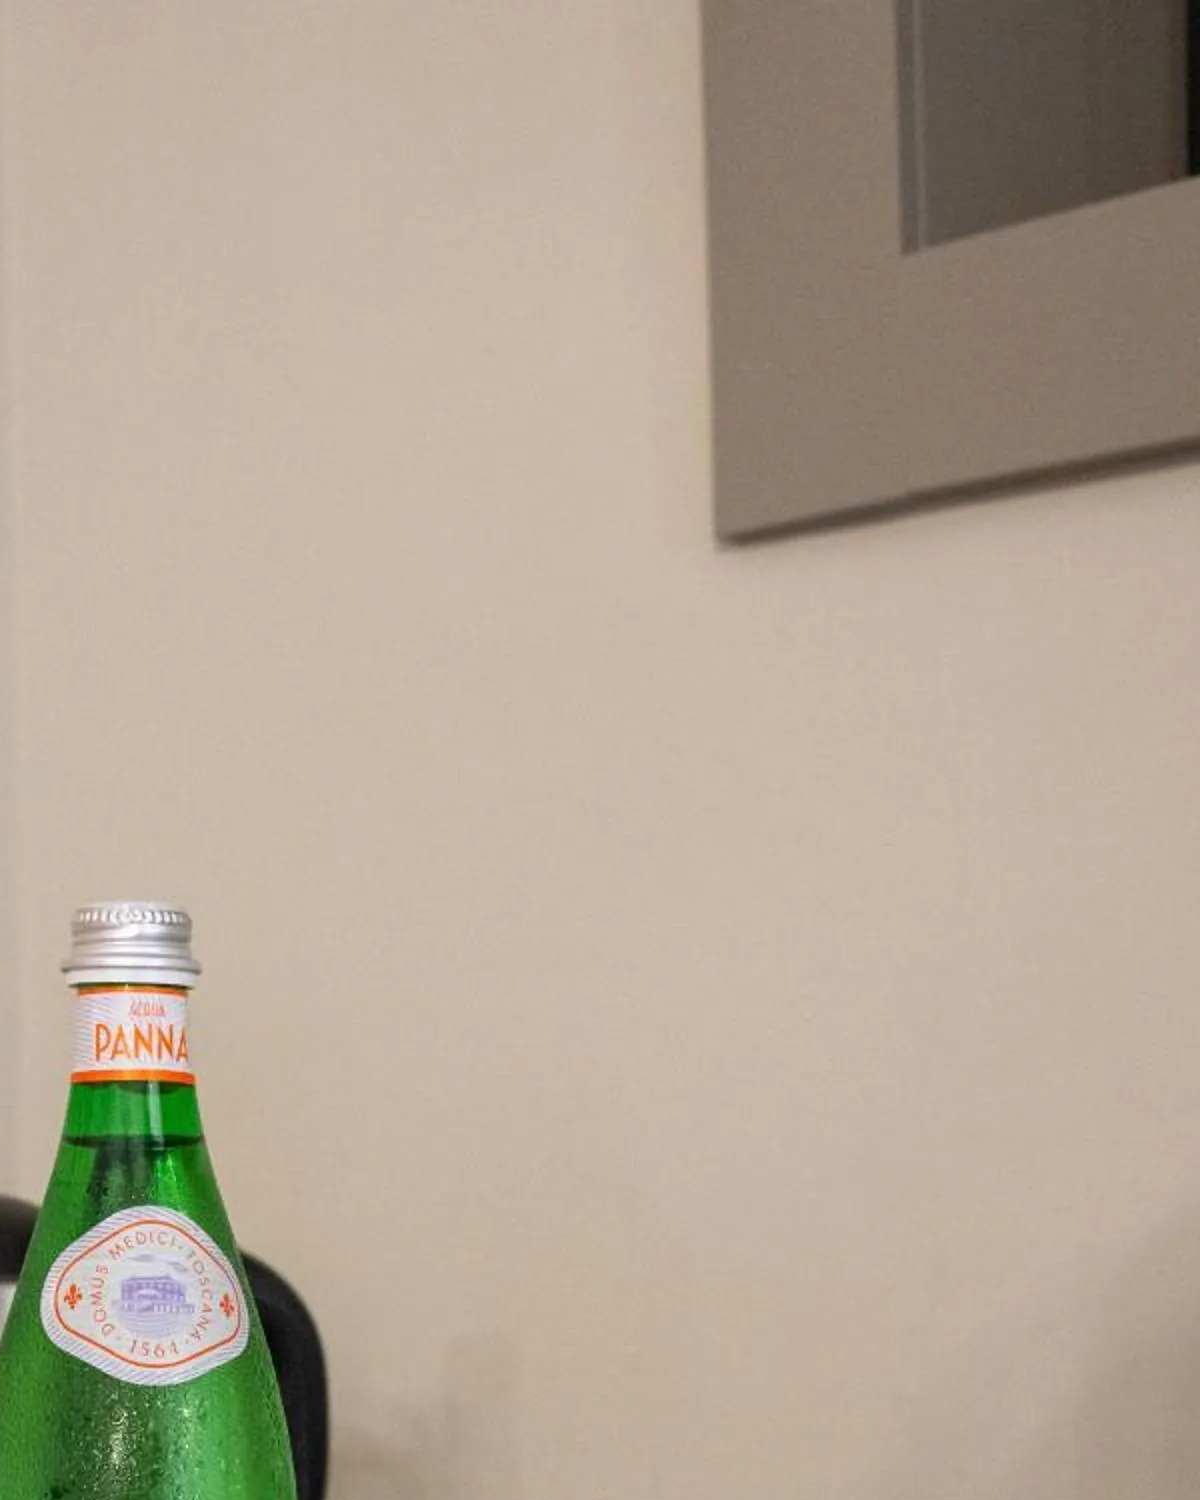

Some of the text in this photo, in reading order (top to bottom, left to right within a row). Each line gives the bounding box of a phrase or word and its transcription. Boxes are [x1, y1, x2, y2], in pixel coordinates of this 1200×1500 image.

[94, 1022, 189, 1063] PANNA
[89, 1230, 178, 1337] DOMUS MEDICI
[184, 1247, 213, 1341] TOSCANA
